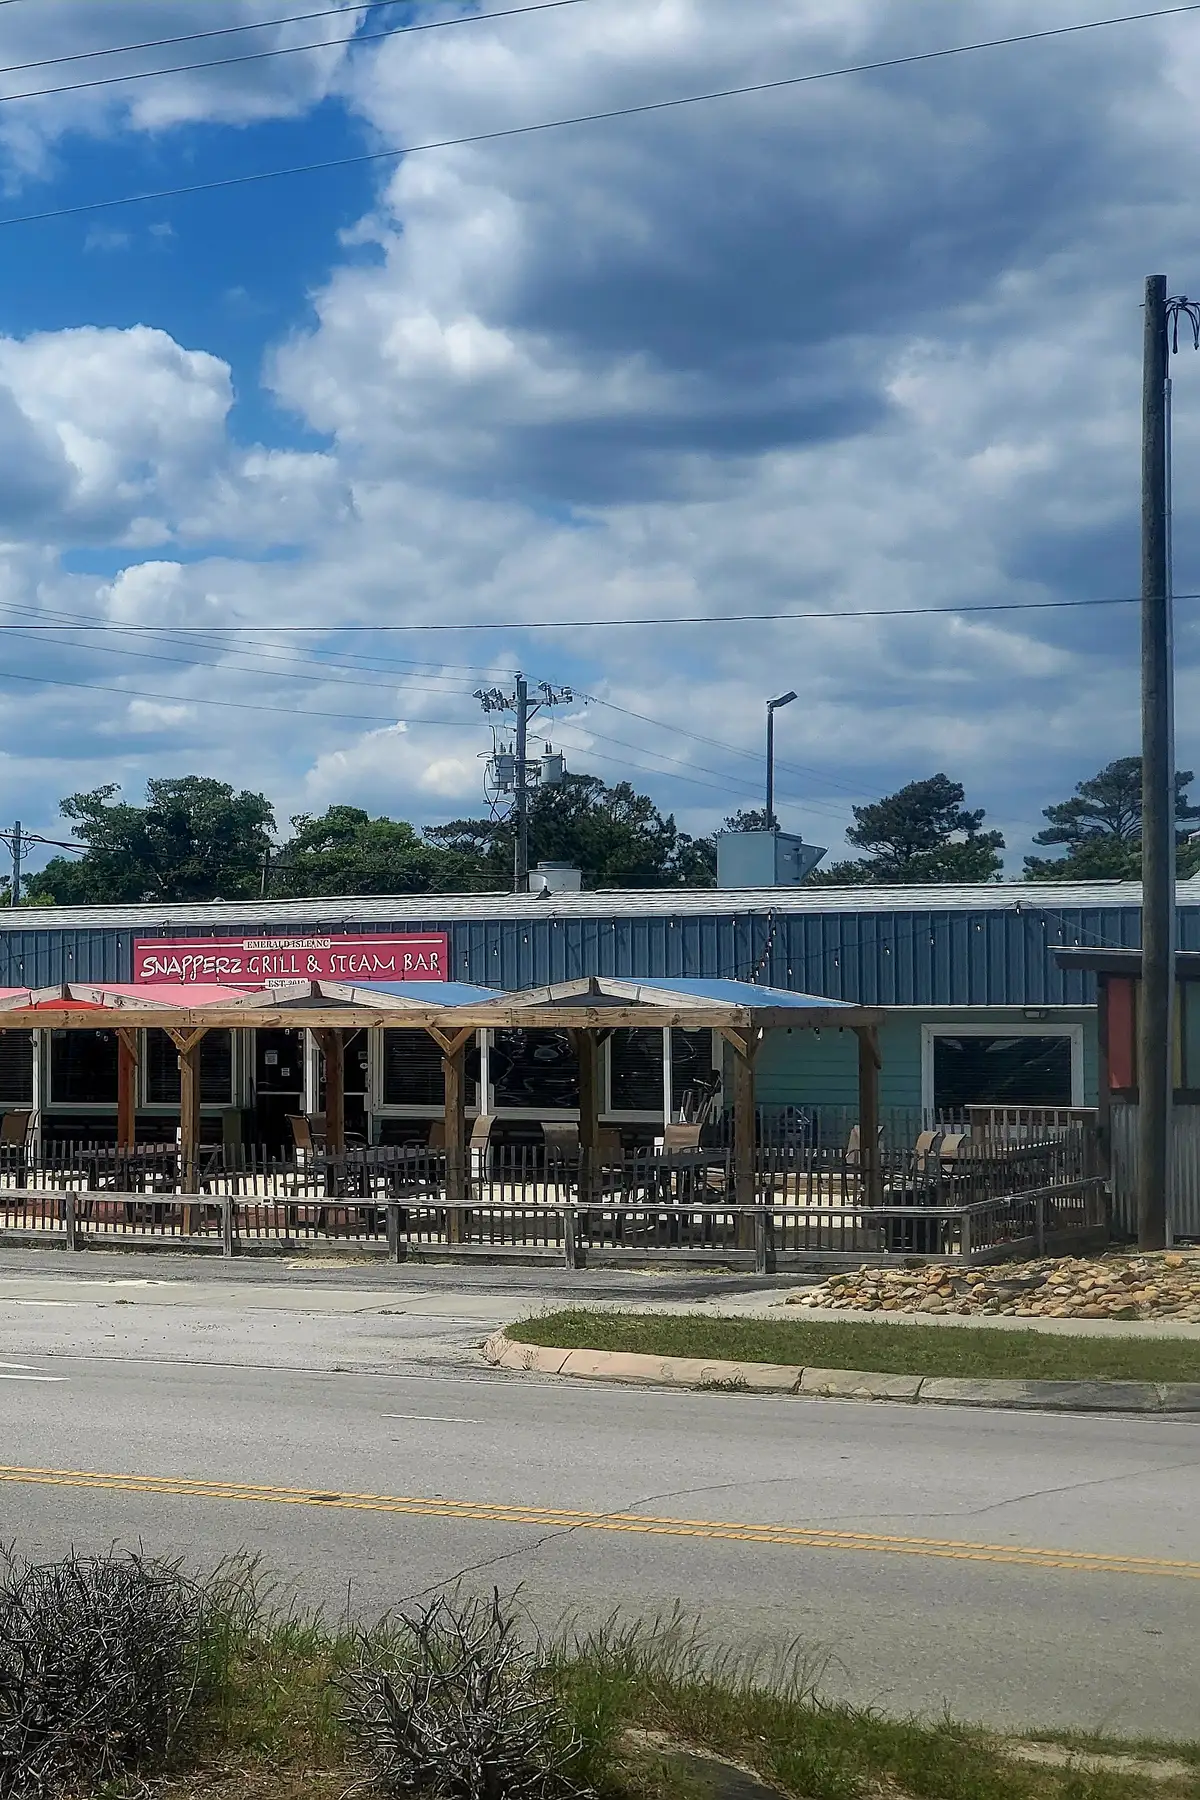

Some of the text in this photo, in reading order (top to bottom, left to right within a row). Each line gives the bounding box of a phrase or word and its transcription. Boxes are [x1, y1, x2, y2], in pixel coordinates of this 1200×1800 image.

[247, 940, 290, 949] EMERALD
[316, 939, 329, 948] NC
[140, 952, 439, 981] SNAPPERZ GRILL & STEAM BAR
